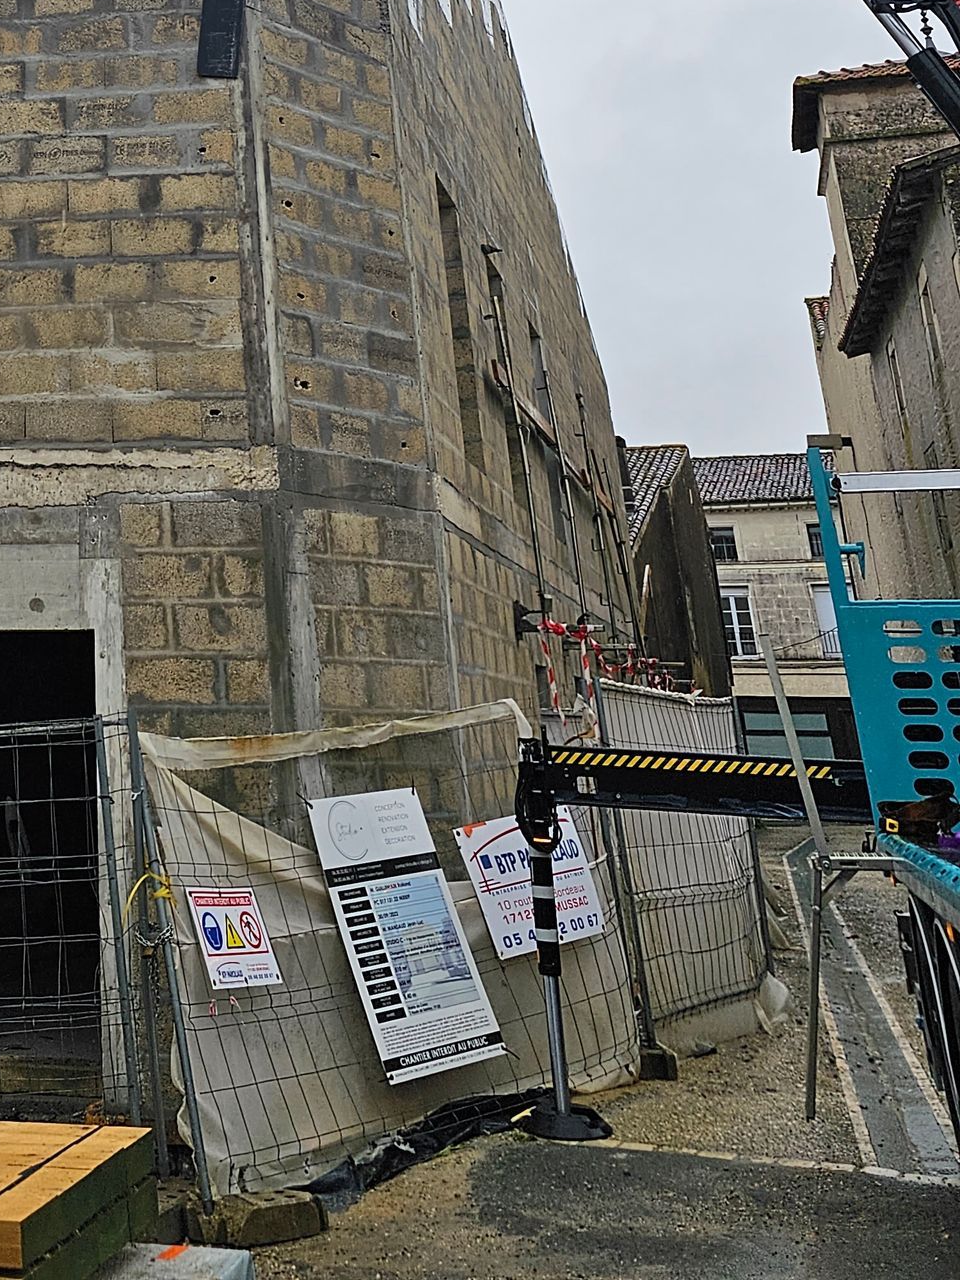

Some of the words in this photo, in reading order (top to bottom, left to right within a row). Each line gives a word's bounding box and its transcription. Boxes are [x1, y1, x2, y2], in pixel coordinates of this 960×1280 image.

[494, 851, 517, 874] BTP
[498, 900, 511, 911] 10
[514, 897, 533, 907] rout
[555, 896, 589, 912] MUSSAC
[503, 933, 522, 948] 05
[570, 918, 585, 931] 00
[587, 914, 598, 926] 67
[400, 1051, 431, 1066] CHANTIER
[431, 1046, 457, 1059] INTERDIT
[458, 1042, 467, 1051] AU
[467, 1037, 488, 1049] PUBLIC
